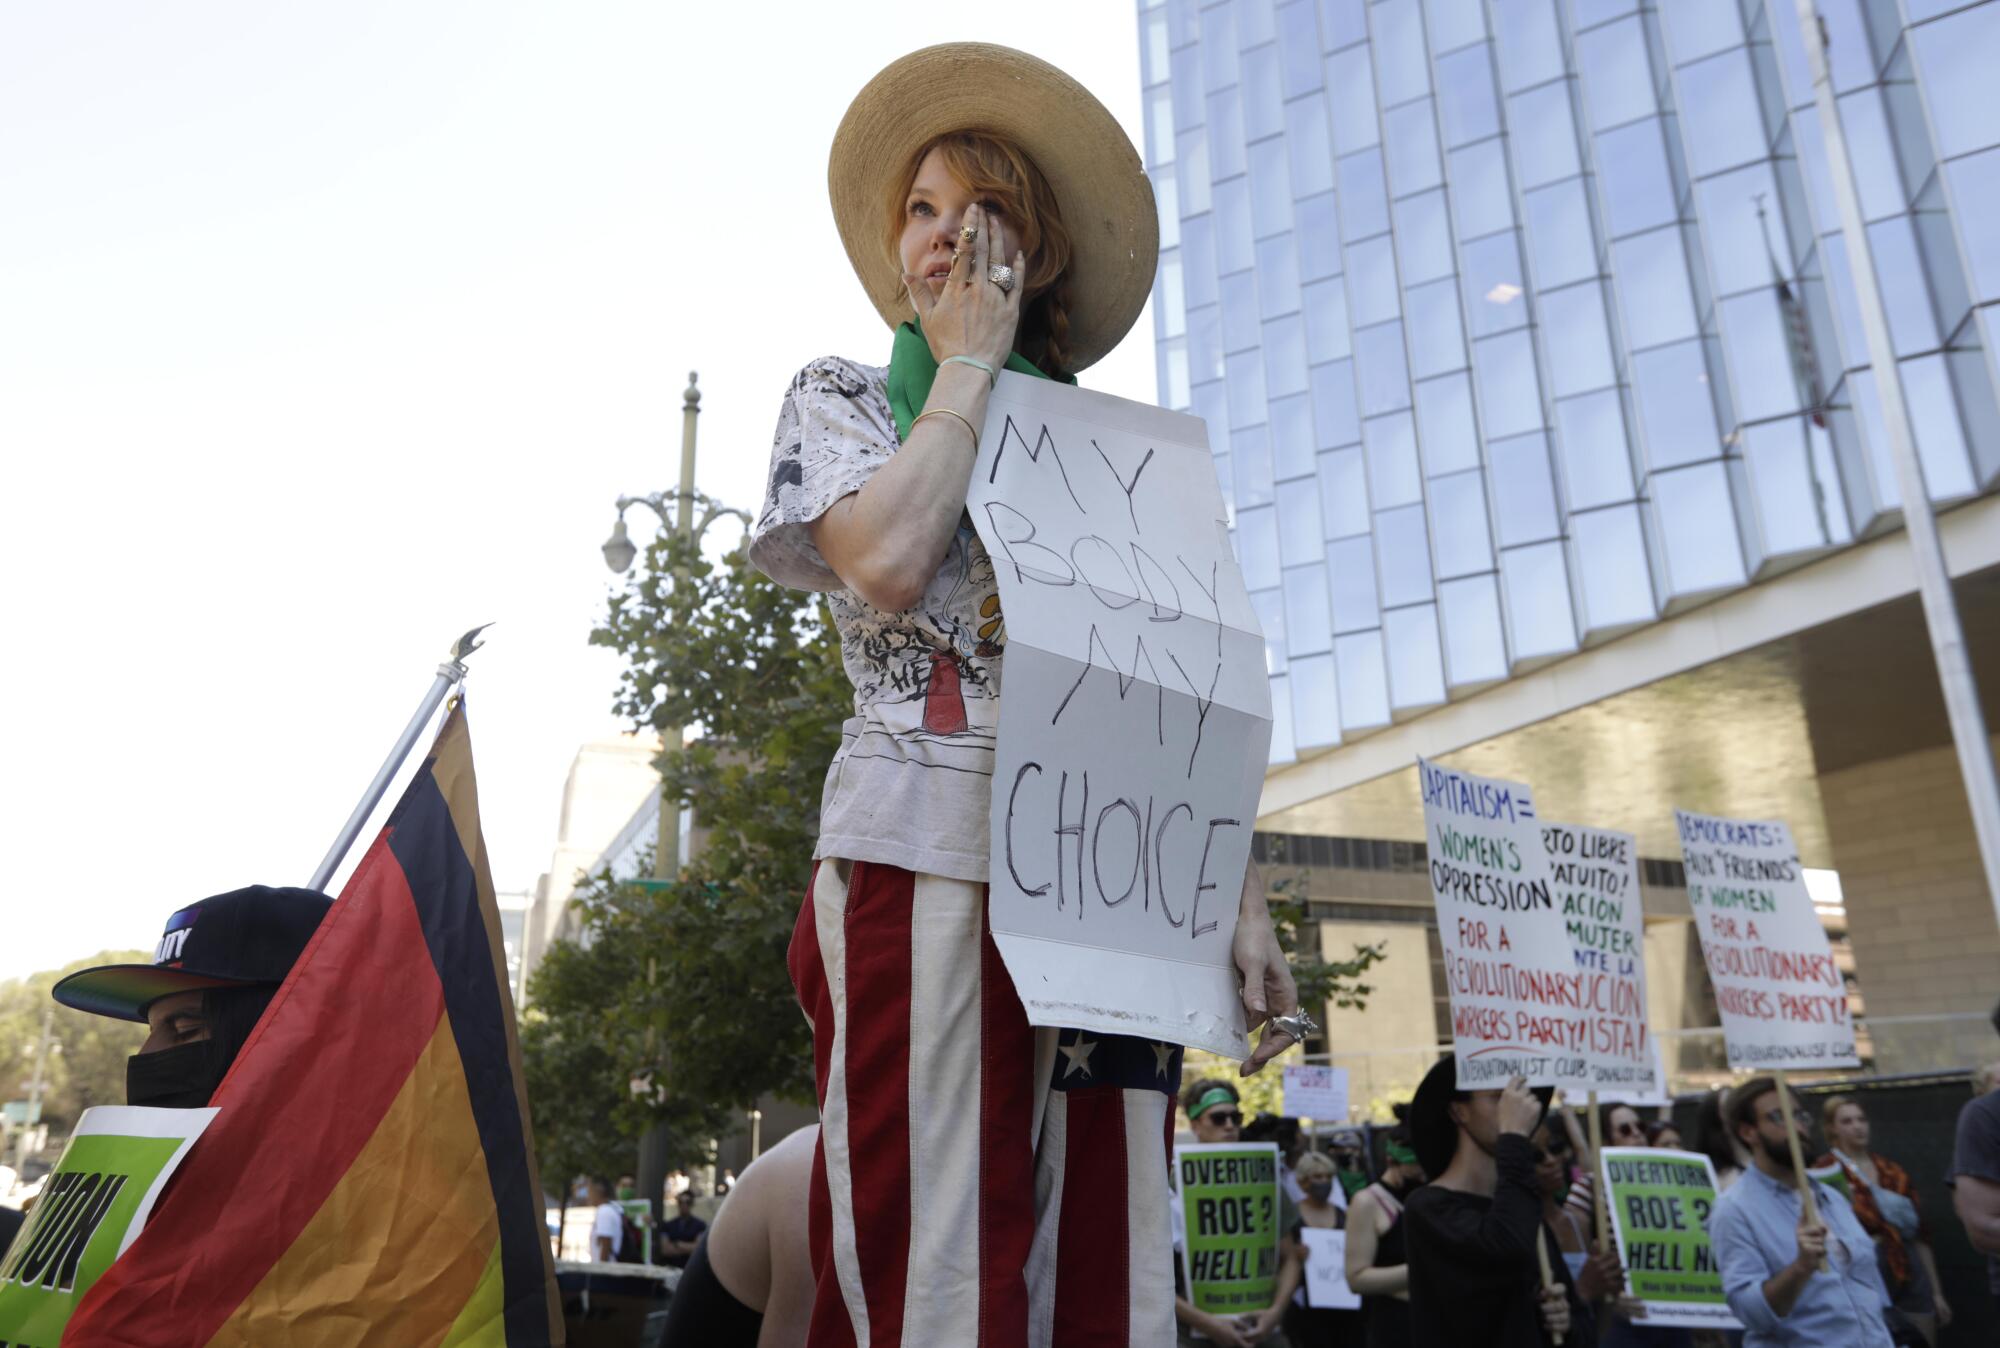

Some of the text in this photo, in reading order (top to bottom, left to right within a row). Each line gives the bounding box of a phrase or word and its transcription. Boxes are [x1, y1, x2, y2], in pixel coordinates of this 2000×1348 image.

[990, 413, 1154, 535] MY
[984, 501, 1223, 658] BODY
[1052, 623, 1222, 779] MY
[1006, 761, 1241, 939] CHOICE
[1436, 823, 1521, 872] WOMEN'S
[1581, 832, 1628, 865] LIBRE
[1432, 858, 1552, 911] OPPRESSION
[1550, 860, 1629, 897] ATUITO!
[1709, 885, 1776, 913] WOMEN
[1458, 916, 1511, 952] FOR A
[1566, 920, 1639, 957] MUJER
[1711, 914, 1760, 941] FOR A
[1446, 949, 1583, 1010] REVOLUTIONARY
[1618, 957, 1634, 975] LA
[1777, 991, 1848, 1026] PARTY!
[1516, 1010, 1586, 1052] PARTY!
[1554, 1057, 1588, 1077] CLUB
[1608, 1161, 1713, 1187] OVERTURN
[1191, 1249, 1251, 1281] HELL
[1629, 1243, 1684, 1271] HELL
